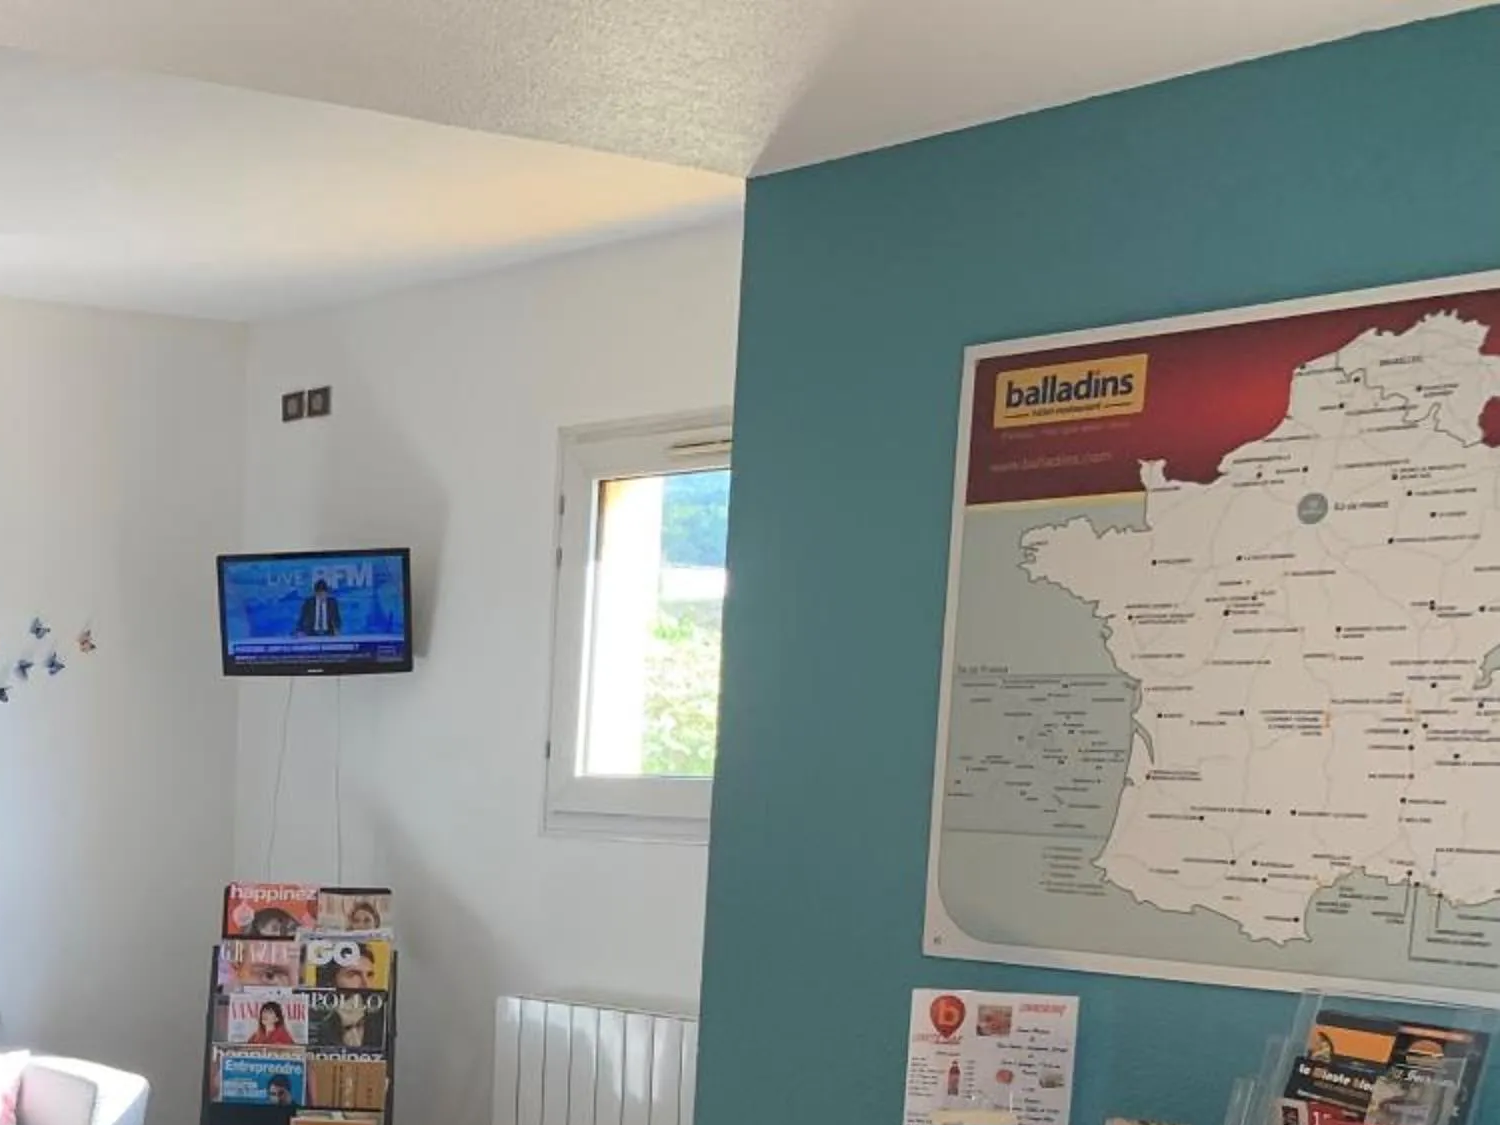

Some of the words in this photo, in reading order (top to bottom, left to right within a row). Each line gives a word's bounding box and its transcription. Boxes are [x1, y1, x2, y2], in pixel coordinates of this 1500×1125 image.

[1006, 370, 1134, 409] balladins
[230, 883, 318, 904] happinez
[307, 940, 361, 968] GQ
[225, 1059, 303, 1077] Entreprendre
